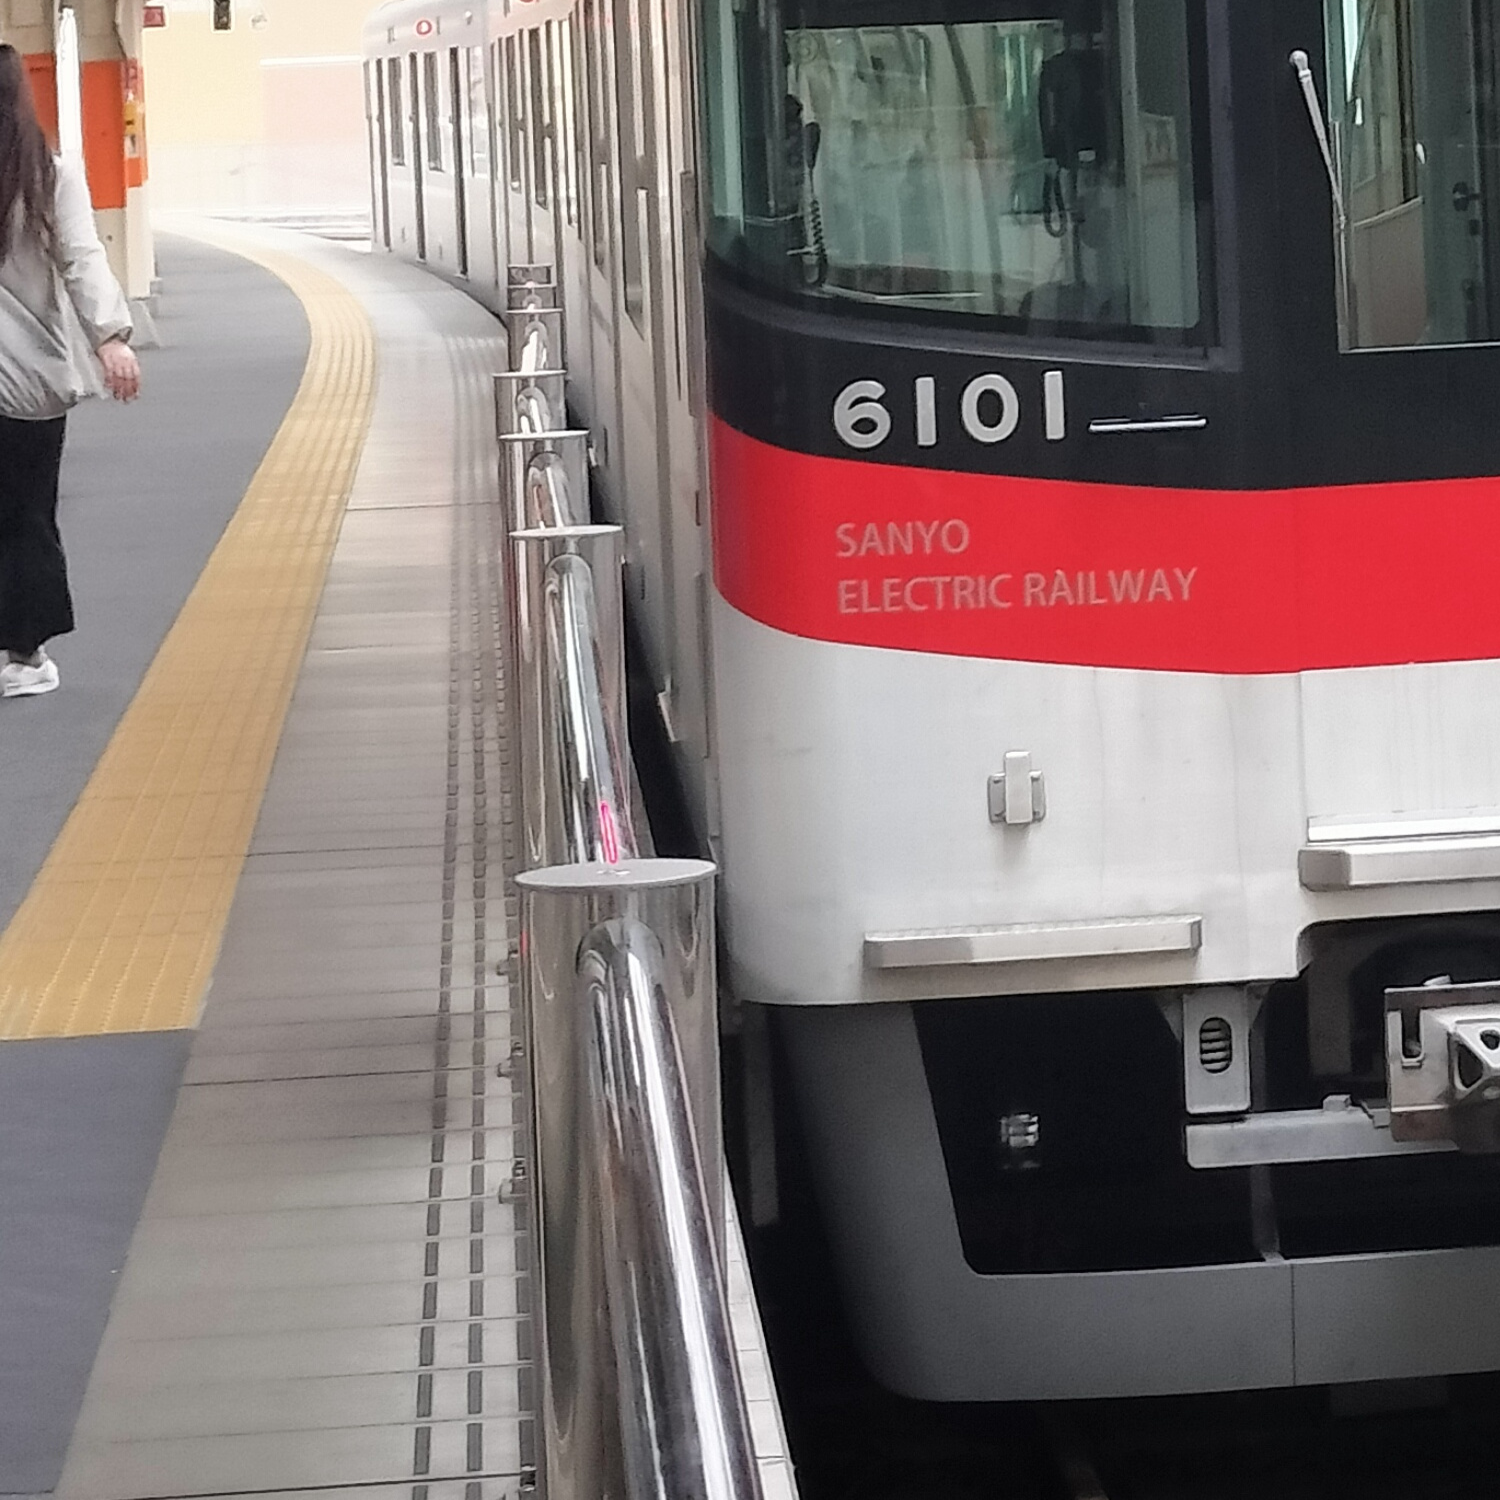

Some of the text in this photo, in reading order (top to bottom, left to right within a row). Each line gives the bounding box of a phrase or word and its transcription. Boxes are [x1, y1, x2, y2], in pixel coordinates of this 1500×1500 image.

[833, 369, 1066, 450] 6101
[836, 518, 970, 558] SANYO
[838, 567, 1197, 614] ELECTRIC RAILWAY
